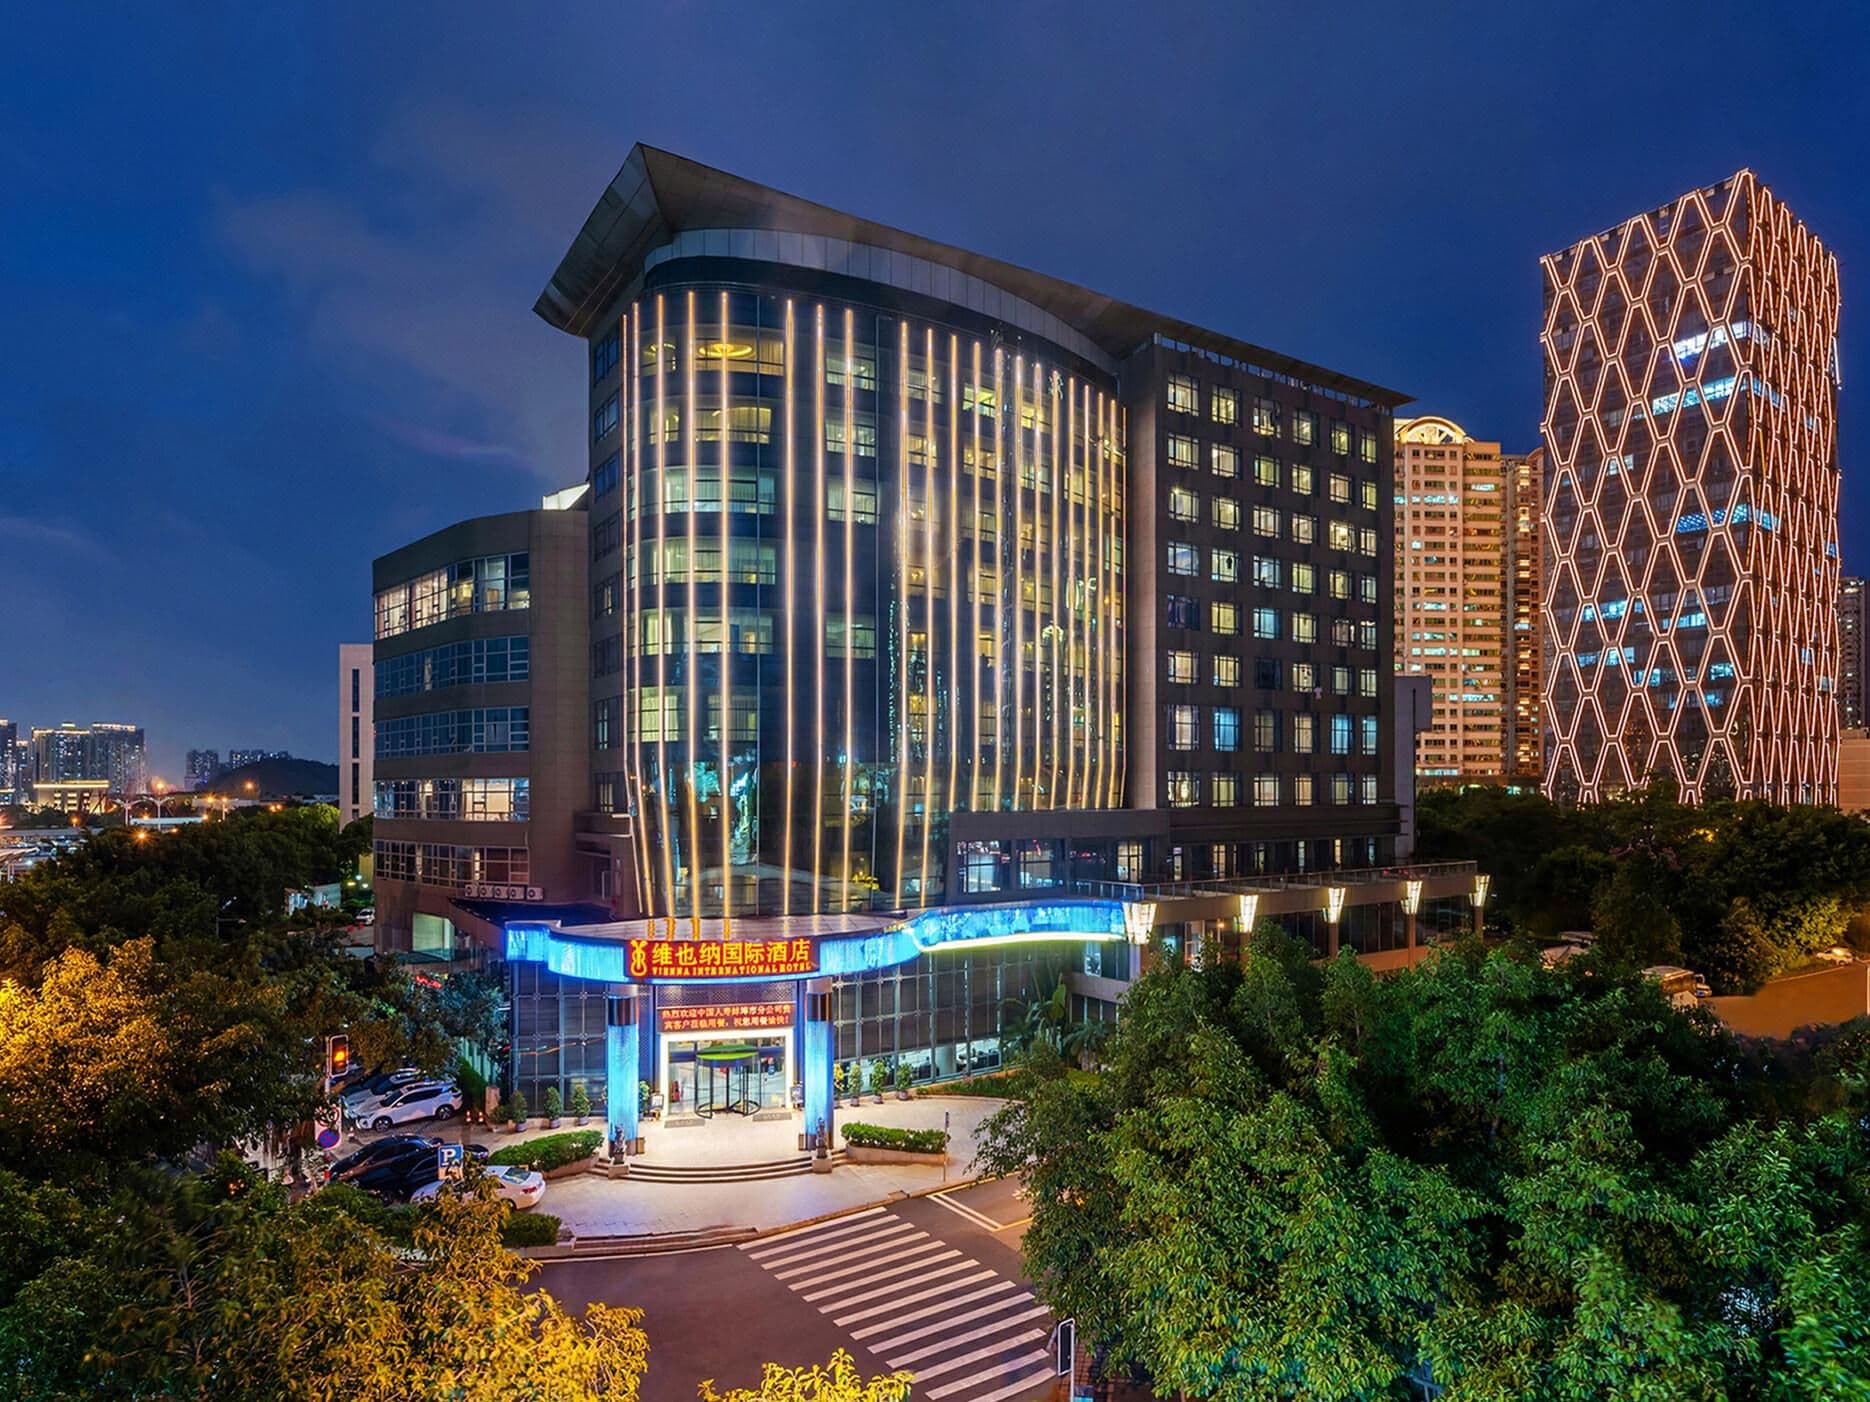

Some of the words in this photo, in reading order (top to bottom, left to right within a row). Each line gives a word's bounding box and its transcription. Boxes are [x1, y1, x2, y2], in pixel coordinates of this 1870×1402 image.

[652, 939, 811, 966] 维也纳国际酒店
[652, 966, 690, 976] VIENNA
[692, 963, 778, 976] INTERNATIONAL
[779, 961, 812, 974] HOTEL
[441, 1148, 456, 1166] P
